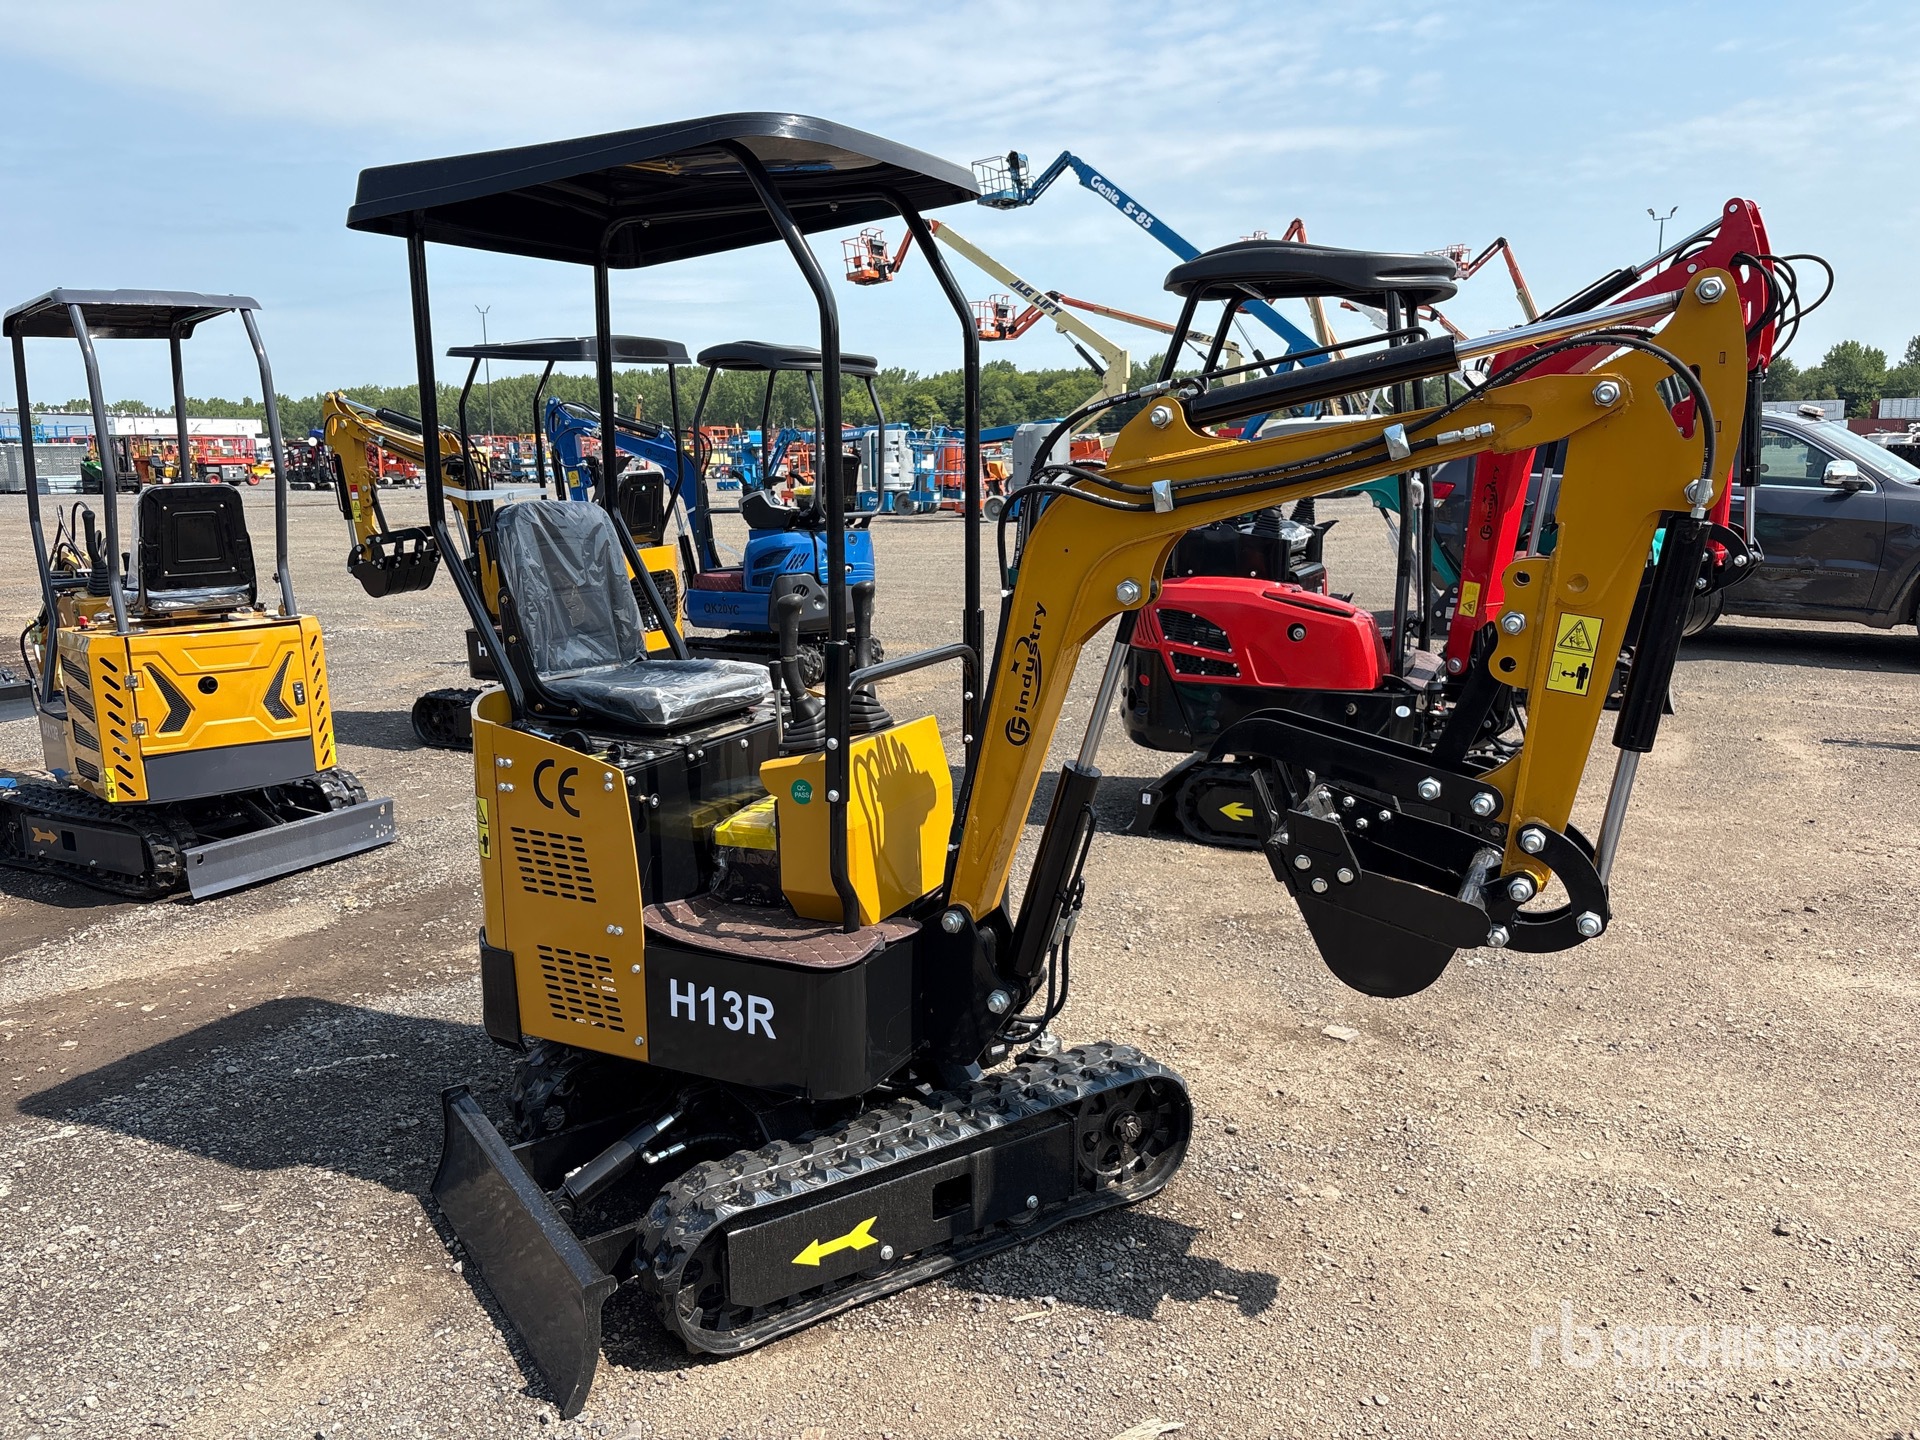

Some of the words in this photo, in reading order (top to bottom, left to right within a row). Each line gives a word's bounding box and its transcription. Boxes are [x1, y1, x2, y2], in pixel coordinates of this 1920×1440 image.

[1090, 175, 1120, 205] Genie
[1123, 201, 1154, 229] S-85
[1009, 280, 1035, 298] JLG
[1033, 294, 1062, 316] LIFT
[704, 602, 740, 616] QK20YC
[533, 758, 580, 818] CE
[670, 978, 777, 1040] H13R
